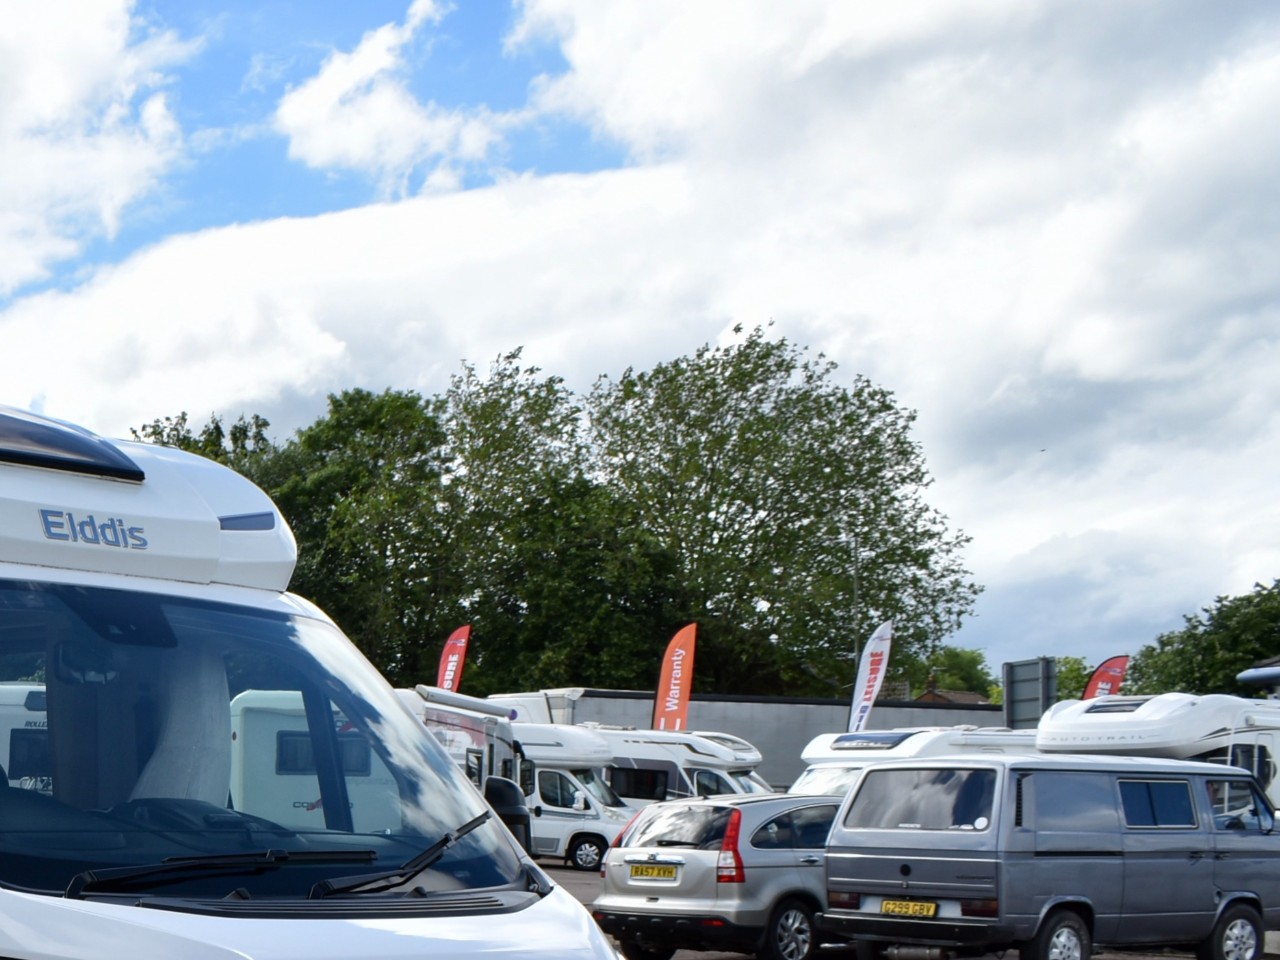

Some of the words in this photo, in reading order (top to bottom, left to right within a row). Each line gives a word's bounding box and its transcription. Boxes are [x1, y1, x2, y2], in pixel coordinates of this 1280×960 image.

[39, 509, 148, 550] Elddis
[665, 648, 686, 711] Warranty
[863, 651, 884, 702] LEISURE
[884, 902, 910, 914] G299
